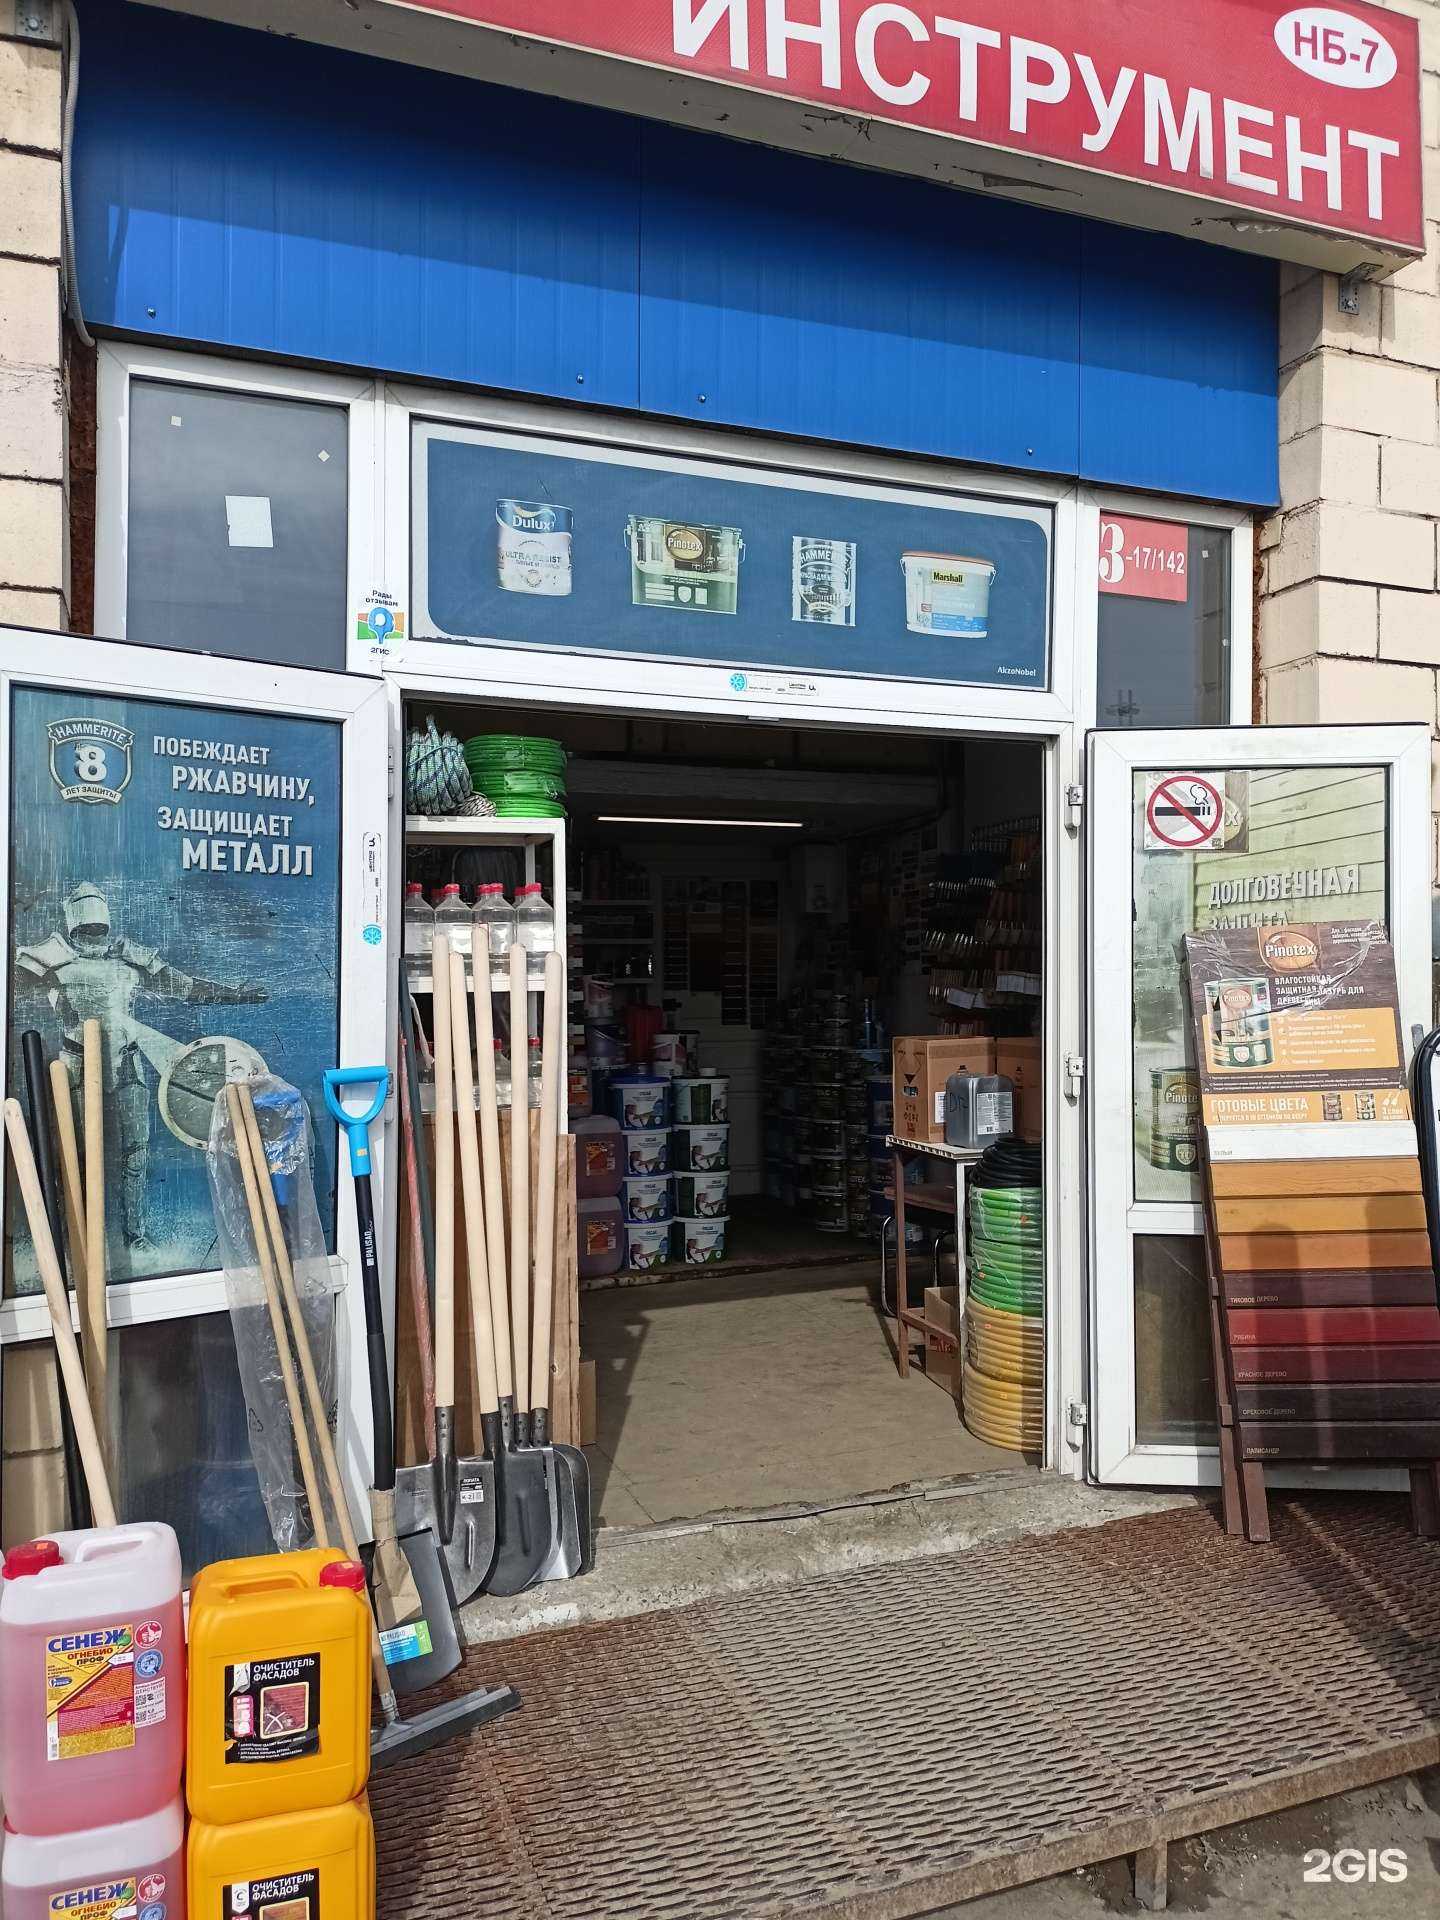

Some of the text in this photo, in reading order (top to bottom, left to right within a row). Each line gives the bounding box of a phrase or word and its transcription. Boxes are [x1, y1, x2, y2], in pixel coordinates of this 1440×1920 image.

[1291, 18, 1382, 75] НБ-7
[670, 0, 1400, 221] ИНСТРУМЕНТ
[512, 514, 551, 530] Dulux
[667, 536, 704, 552] Pinotex
[933, 571, 964, 584] Marshall
[365, 597, 399, 607] отзывам
[372, 589, 392, 600] Рады
[370, 647, 390, 656] 2ГИС
[997, 666, 1037, 677] AkzoNobel
[55, 723, 127, 745] HAMMERITE
[153, 735, 270, 766] ПОБЕЖДАЕТ
[74, 743, 108, 783] 8
[65, 785, 118, 801] ЛЕТ ЗАЩИТЫ
[171, 765, 316, 807] РЖАВЧИНУ,
[157, 806, 293, 838] ЗАЩИЩАЕТ
[181, 837, 314, 877] МЕТАЛЛ
[1208, 864, 1360, 910] ДОЛГОВЕЧНАЯ
[1265, 943, 1316, 959] Pinotex
[1223, 993, 1252, 1003] Pinotex
[1348, 986, 1365, 996] ДЛЯ
[1165, 1091, 1200, 1104] Pinote
[1210, 1097, 1309, 1113] ГОТОВЫЕ ЦВЕТА
[365, 1229, 374, 1258] PALISAD
[47, 1628, 127, 1653] СЕНЕЖ
[67, 1647, 114, 1660] ОГНЕБИО
[76, 1655, 105, 1666] ПРОФ
[253, 1657, 315, 1674] ОЧИСТИТЕЛЬ
[253, 1668, 300, 1682] ФАСАДОВ
[251, 1872, 315, 1892] ОЧИСТИТЕЛЬ
[50, 1881, 130, 1911] СЕНЕЖ
[251, 1885, 300, 1902] ФАСАДОВ
[70, 1900, 117, 1916] ОГНЕБИО
